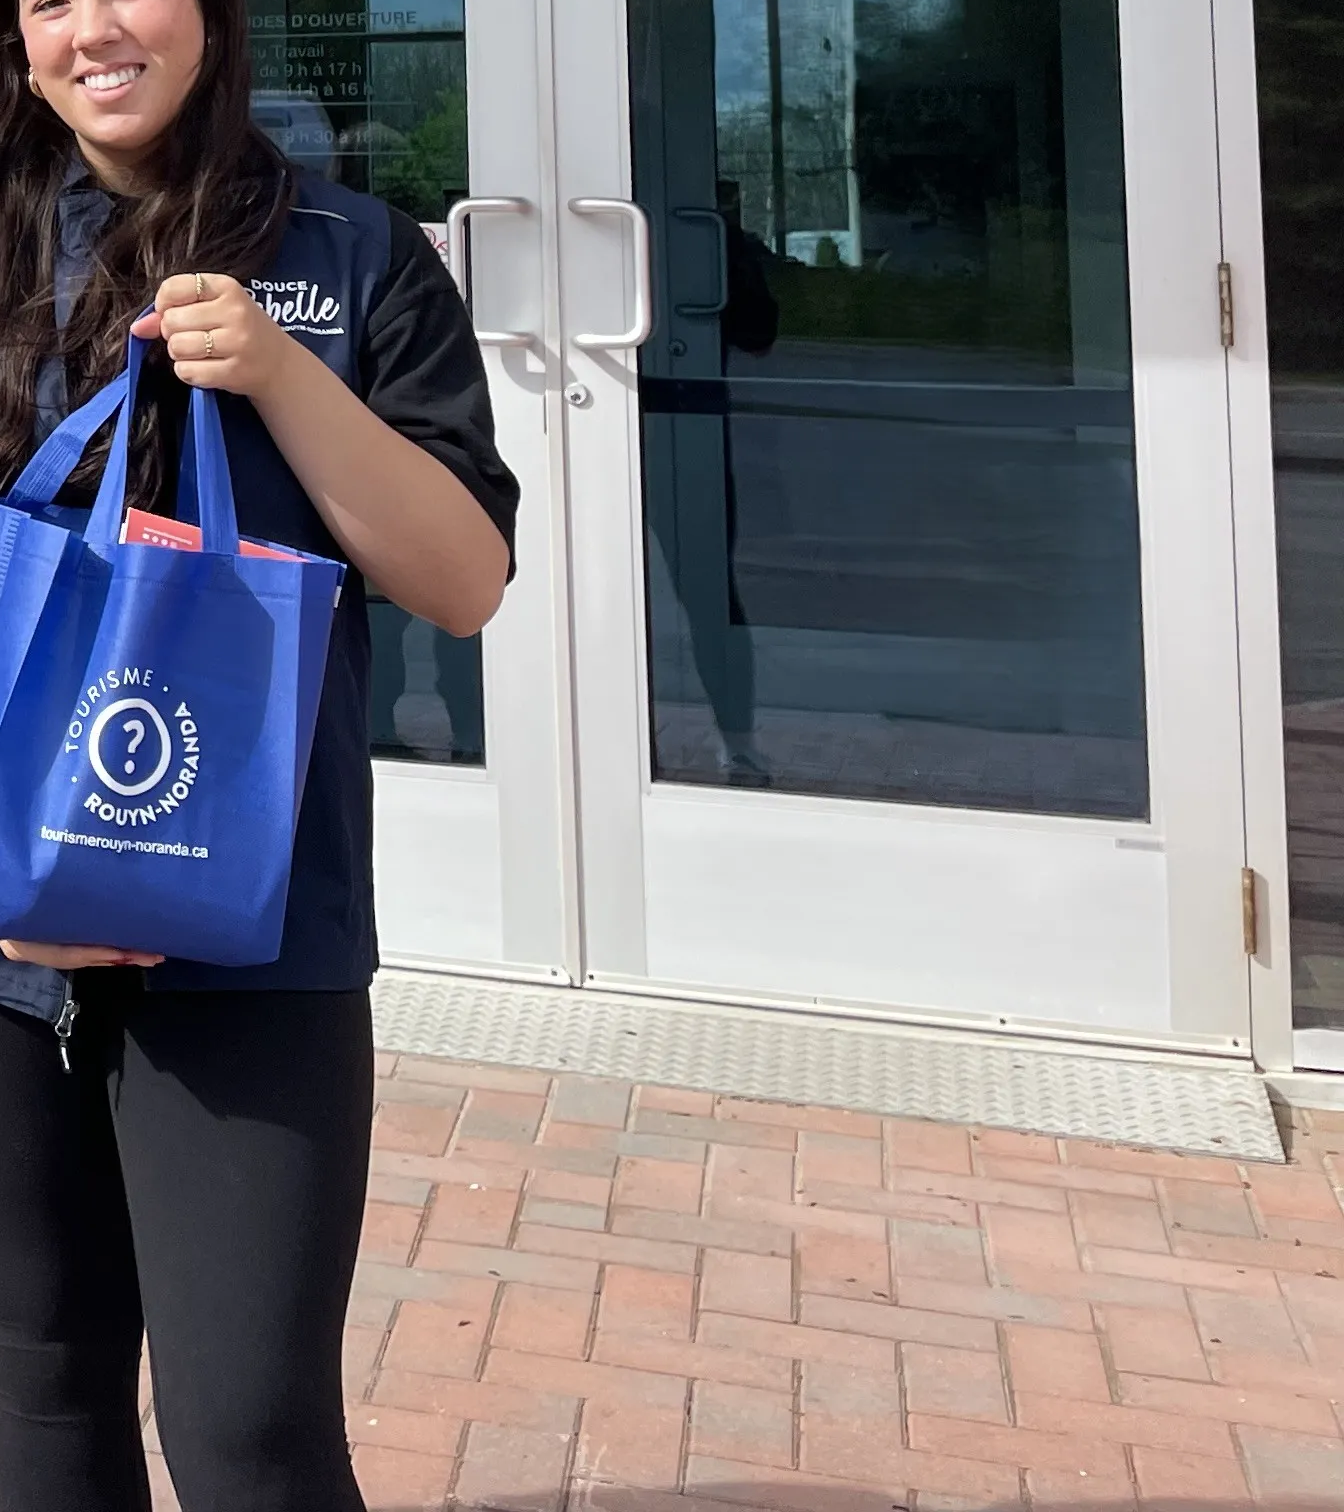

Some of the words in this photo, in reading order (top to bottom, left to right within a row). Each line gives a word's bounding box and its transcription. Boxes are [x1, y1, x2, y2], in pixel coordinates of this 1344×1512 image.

[291, 11, 417, 27] D'OUVERTURE
[274, 44, 325, 58] Travail
[284, 63, 293, 77] 9
[297, 63, 308, 76] h
[312, 62, 323, 76] à
[329, 63, 347, 75] 17
[351, 62, 362, 75] h
[341, 83, 358, 96] 16
[251, 278, 308, 292] DOUCE
[65, 667, 154, 754] TOURISME
[83, 701, 200, 826] ROUYN-NORANDA
[41, 825, 209, 859] tourismerouyn-noranda.ca
